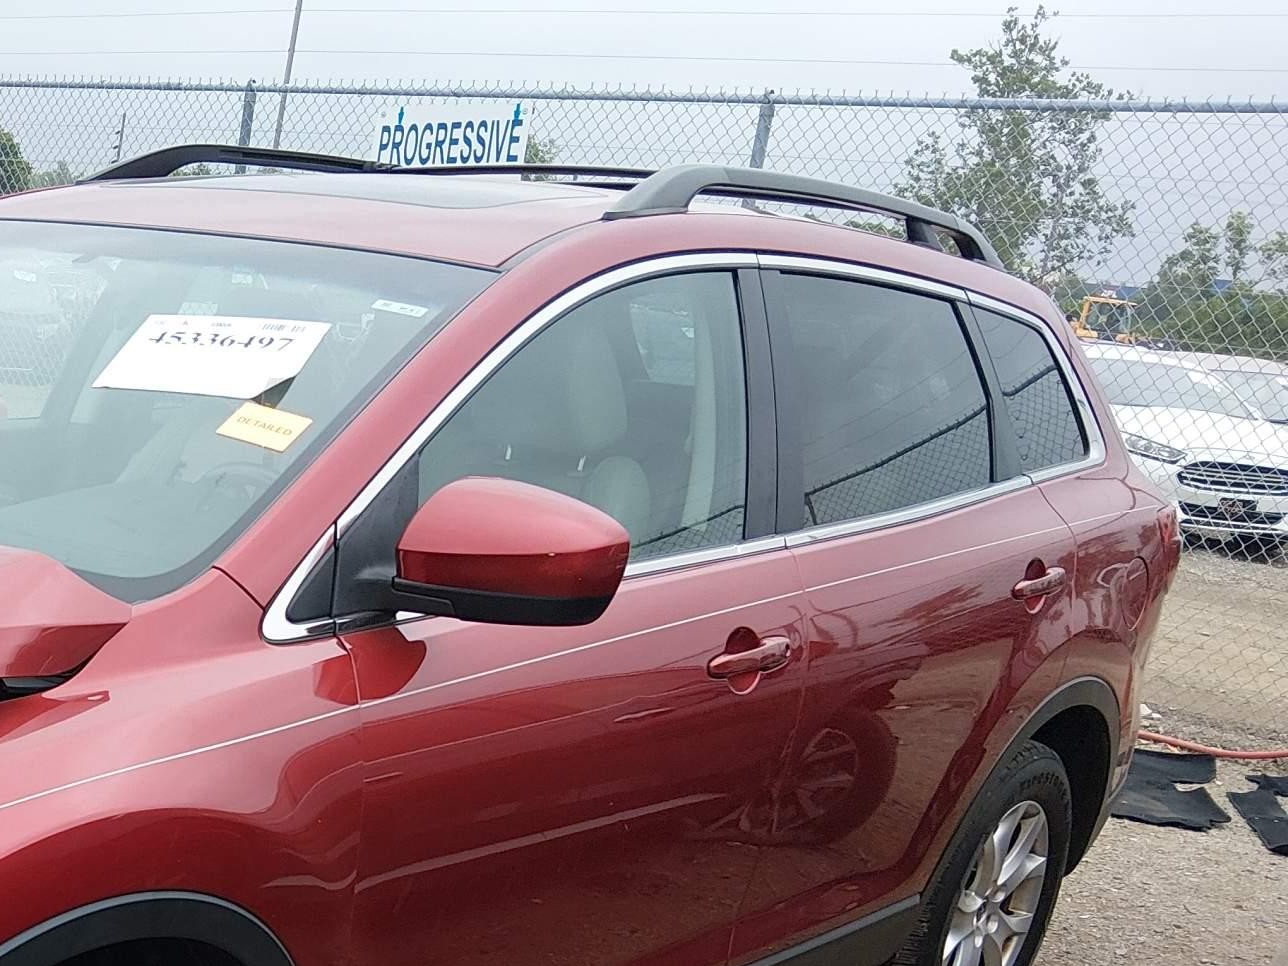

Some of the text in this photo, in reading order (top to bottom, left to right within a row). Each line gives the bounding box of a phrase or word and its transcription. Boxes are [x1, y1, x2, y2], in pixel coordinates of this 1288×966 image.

[377, 119, 523, 165] PROGRESSIVE
[149, 330, 296, 351] 45336497
[236, 416, 293, 436] DETAILED
